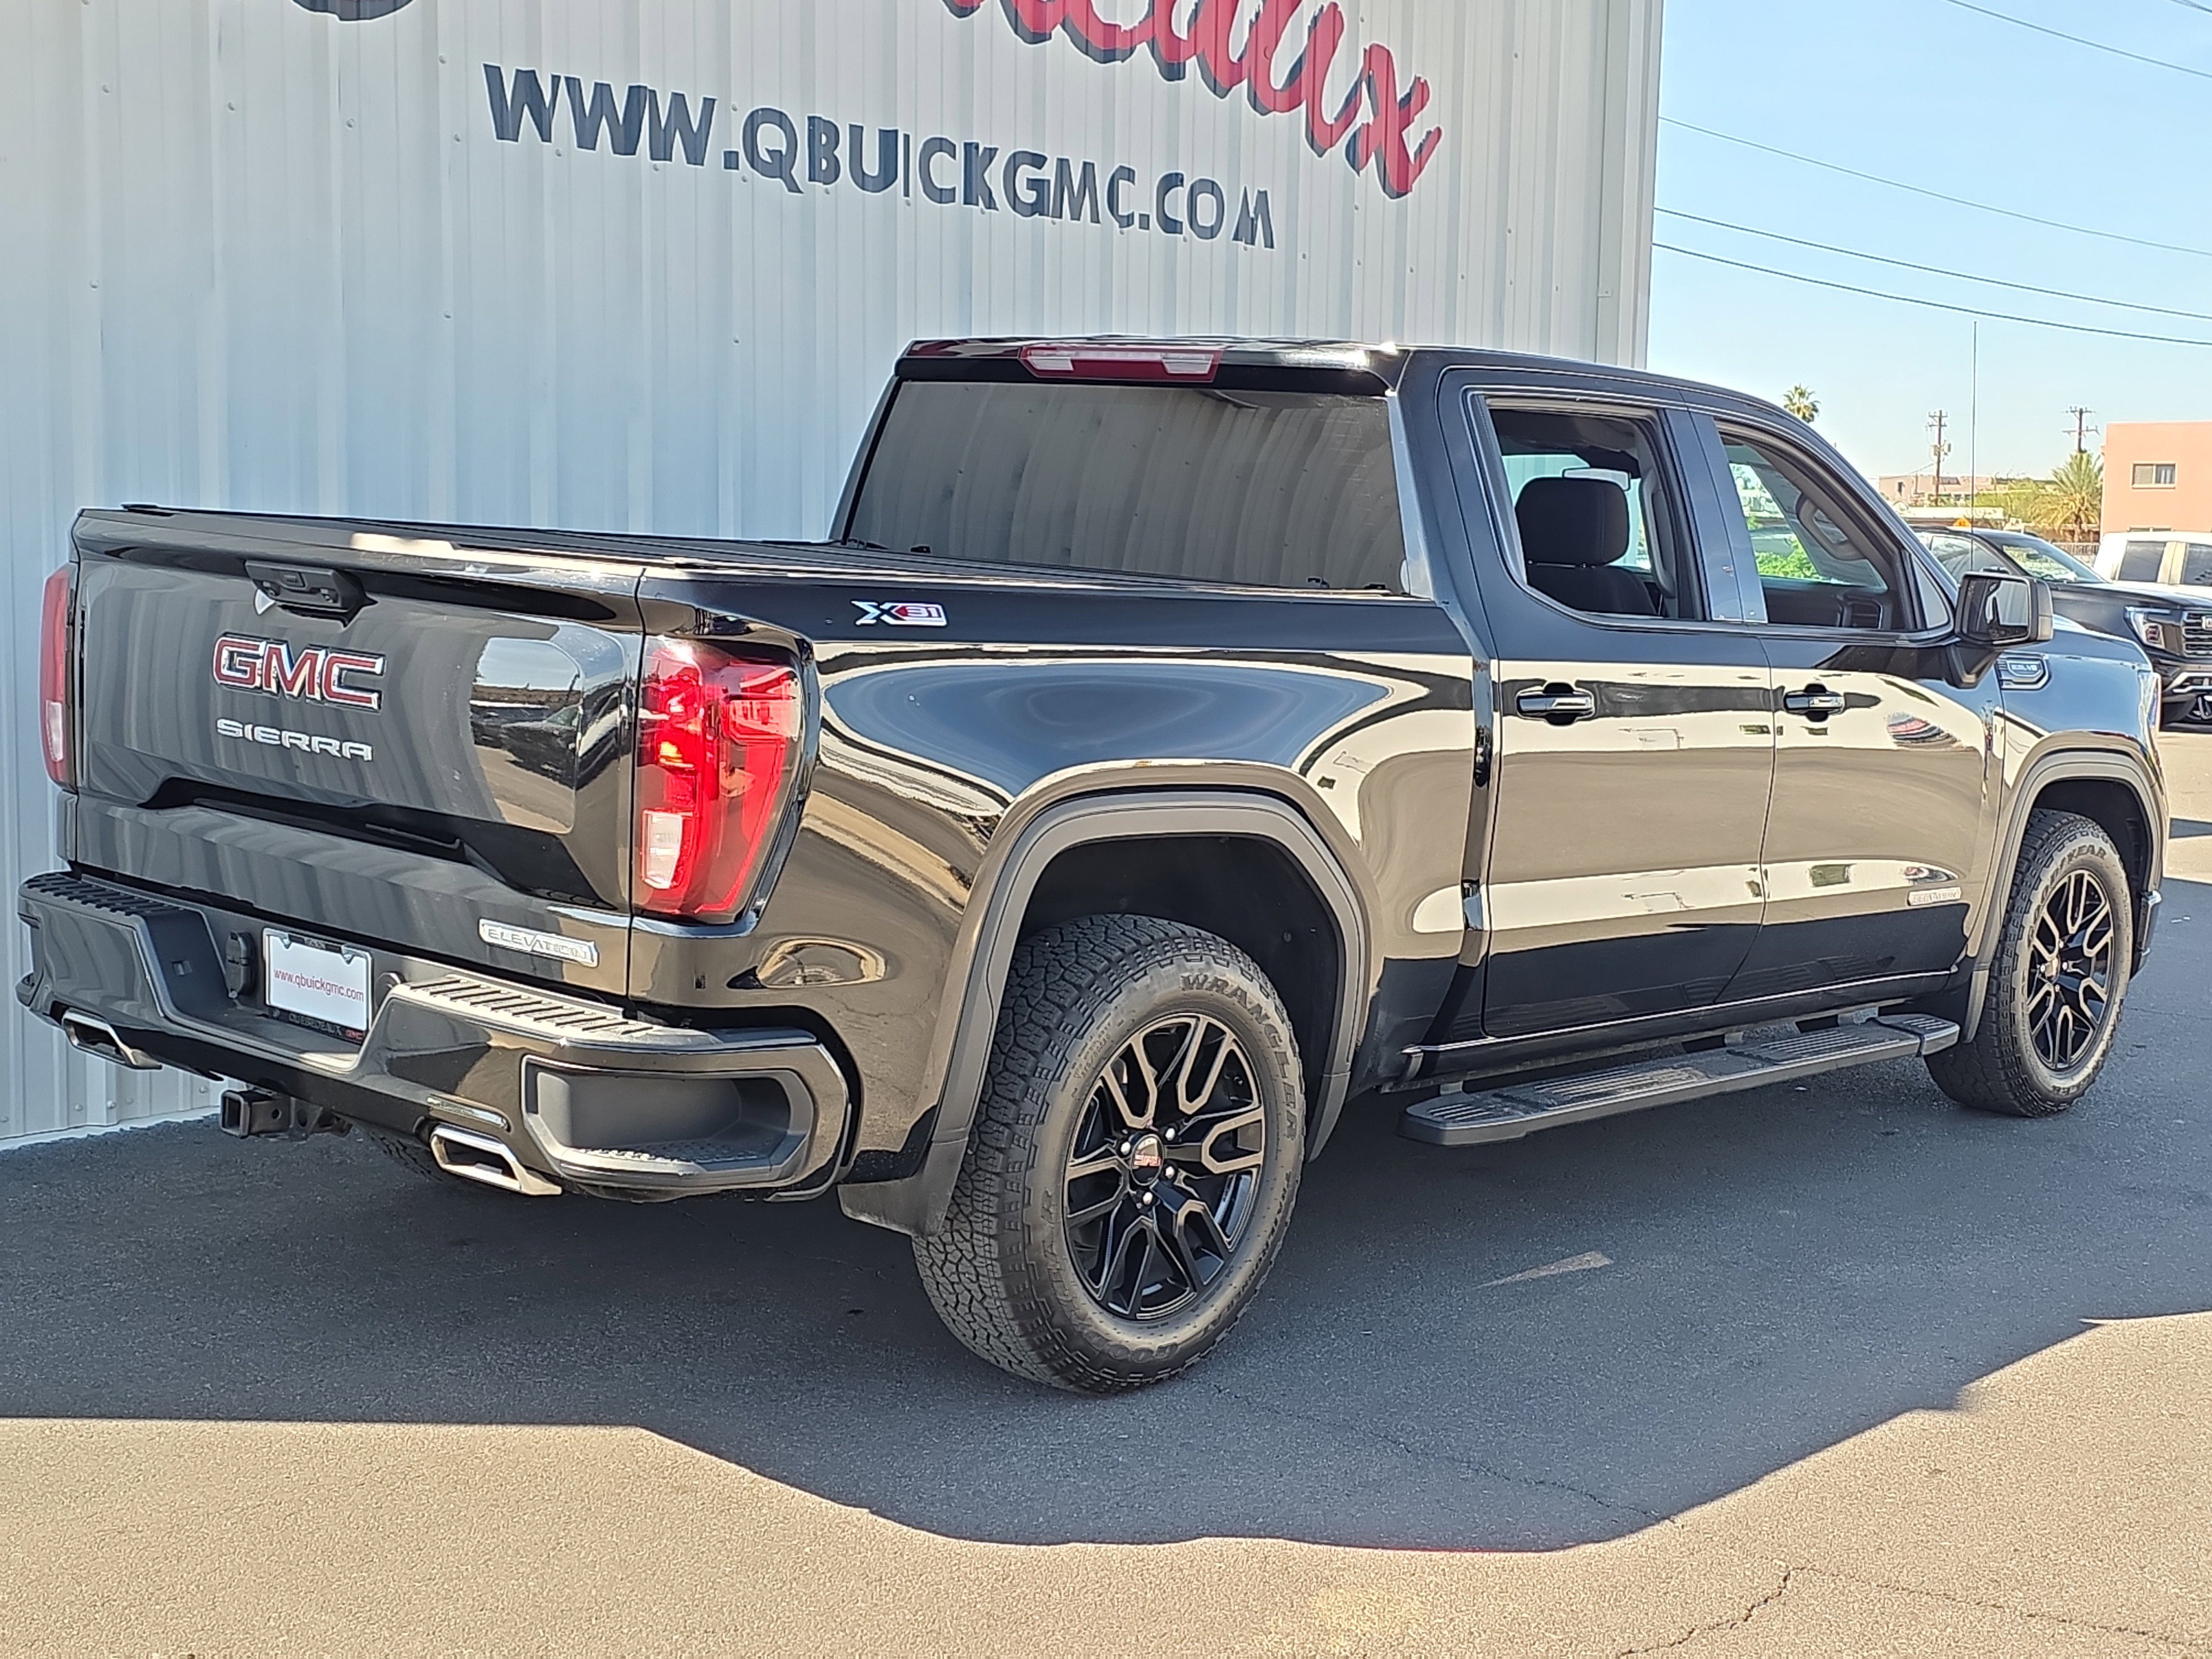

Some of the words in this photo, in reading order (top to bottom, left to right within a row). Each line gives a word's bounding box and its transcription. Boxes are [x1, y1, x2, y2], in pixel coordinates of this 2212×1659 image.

[483, 63, 1276, 249] WWW.QBUICKGMC.COM
[851, 601, 948, 626] X31
[213, 632, 386, 713] GMC
[216, 718, 374, 762] SIERRA
[487, 928, 588, 960] ELEVATION
[273, 968, 364, 1002] www.qbuickgmc.com
[1180, 974, 1298, 1141] WRANGLER
